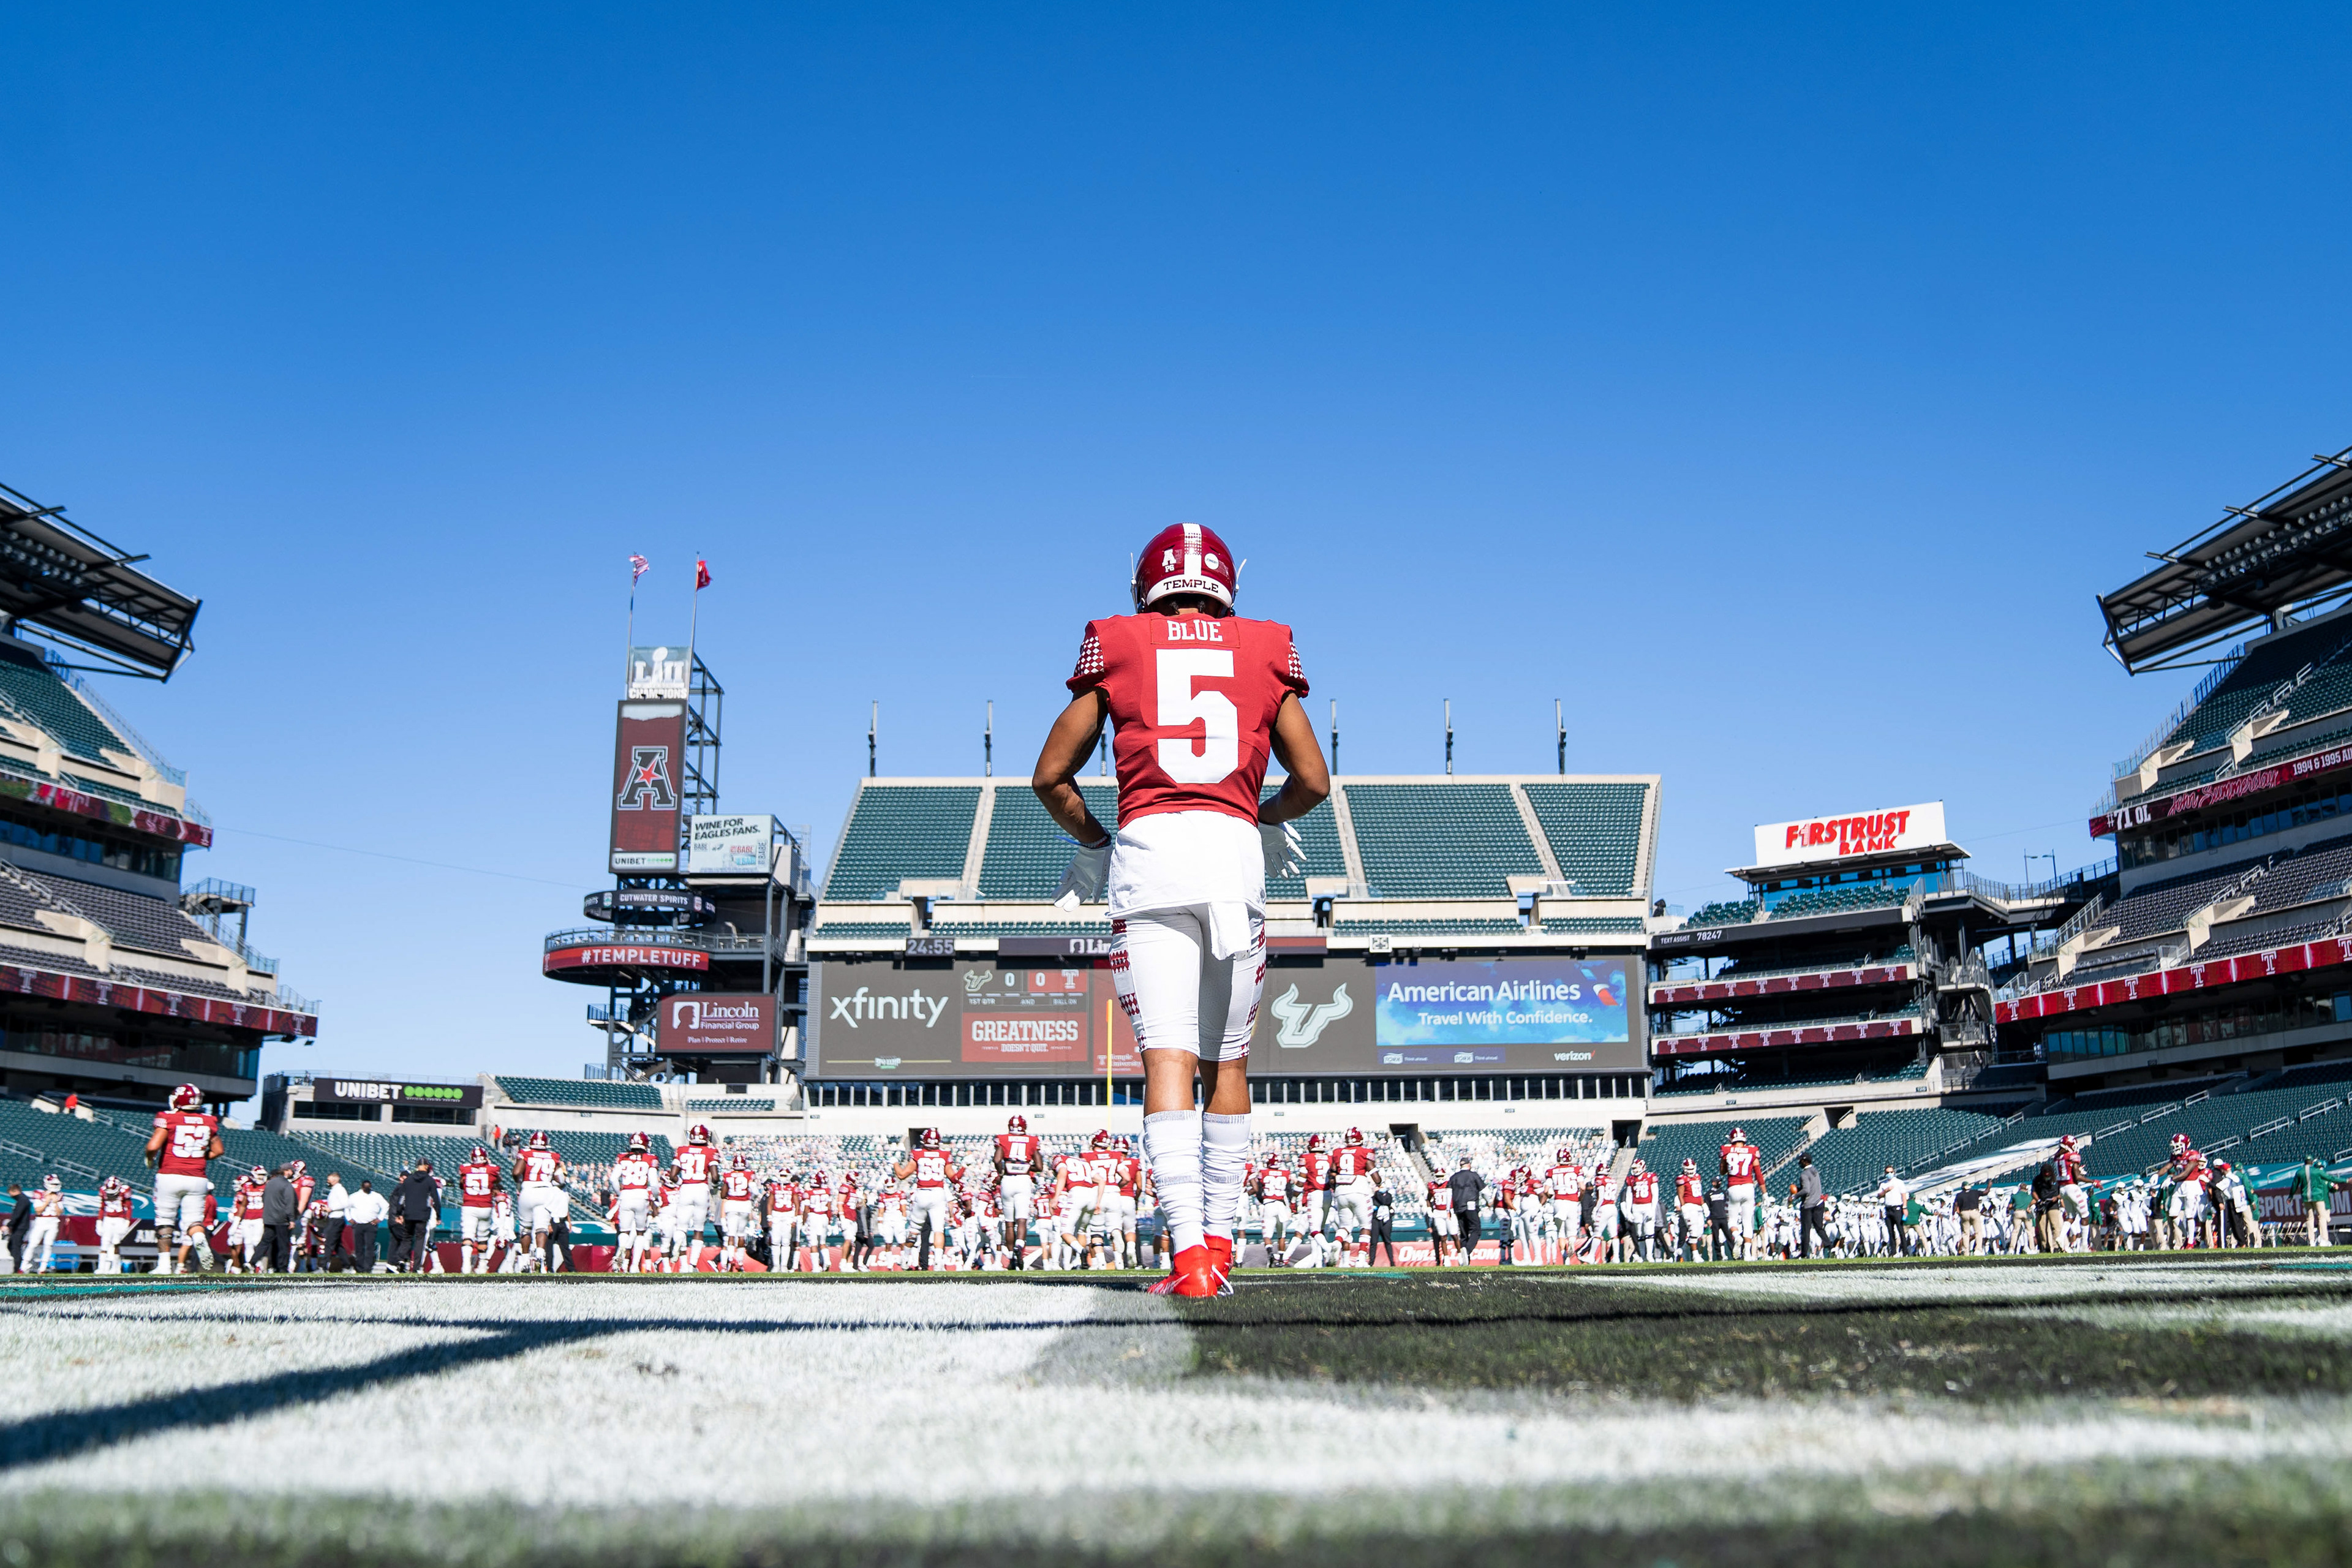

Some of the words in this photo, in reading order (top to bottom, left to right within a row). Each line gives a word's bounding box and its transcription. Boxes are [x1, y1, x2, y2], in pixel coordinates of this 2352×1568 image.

[1164, 579, 1219, 593] TEMPLE
[1167, 619, 1223, 642] BLUE
[628, 688, 687, 699] CHAMPIONS
[1156, 649, 1239, 783] 5
[2293, 762, 2313, 775] 1994
[2315, 757, 2320, 769] &
[2321, 751, 2341, 767] 1995
[617, 745, 677, 810] A
[695, 821, 722, 831] WINE
[723, 818, 744, 827] FOR
[2107, 807, 2133, 830] #71
[2135, 805, 2151, 825] OL
[695, 829, 731, 840] EAGLES
[733, 825, 760, 836] FANS.
[1839, 835, 1898, 855] BANK
[660, 895, 688, 905] SPIRITS
[1373, 938, 1389, 949] 25
[1697, 930, 1722, 941] 78247
[907, 940, 954, 954] 24:55
[582, 949, 701, 967] #TEMPLETUFF
[1005, 972, 1015, 987] 0
[1036, 972, 1046, 987] 0
[1387, 981, 1493, 1003] American
[1496, 980, 1581, 1001] Airlines
[701, 1001, 759, 1018] Lincoln
[829, 987, 949, 1028] xfinity
[1417, 1012, 1463, 1025] Travel
[1466, 1011, 1502, 1025] With
[1506, 1009, 1593, 1023] Confidence.
[736, 1021, 759, 1030] Group
[971, 1020, 1079, 1041] GREATNESS
[1554, 1050, 1592, 1061] verizon
[334, 1082, 402, 1100] UNIBET
[172, 1125, 211, 1158] 52
[527, 1158, 556, 1183] 79
[620, 1159, 649, 1186] 38
[680, 1153, 706, 1180] 31
[918, 1158, 946, 1182] 69
[1340, 1154, 1355, 1175] 9
[1726, 1153, 1752, 1176] 87
[726, 1177, 748, 1196] 12
[1263, 1176, 1287, 1196] 39
[1552, 1174, 1578, 1195] 46
